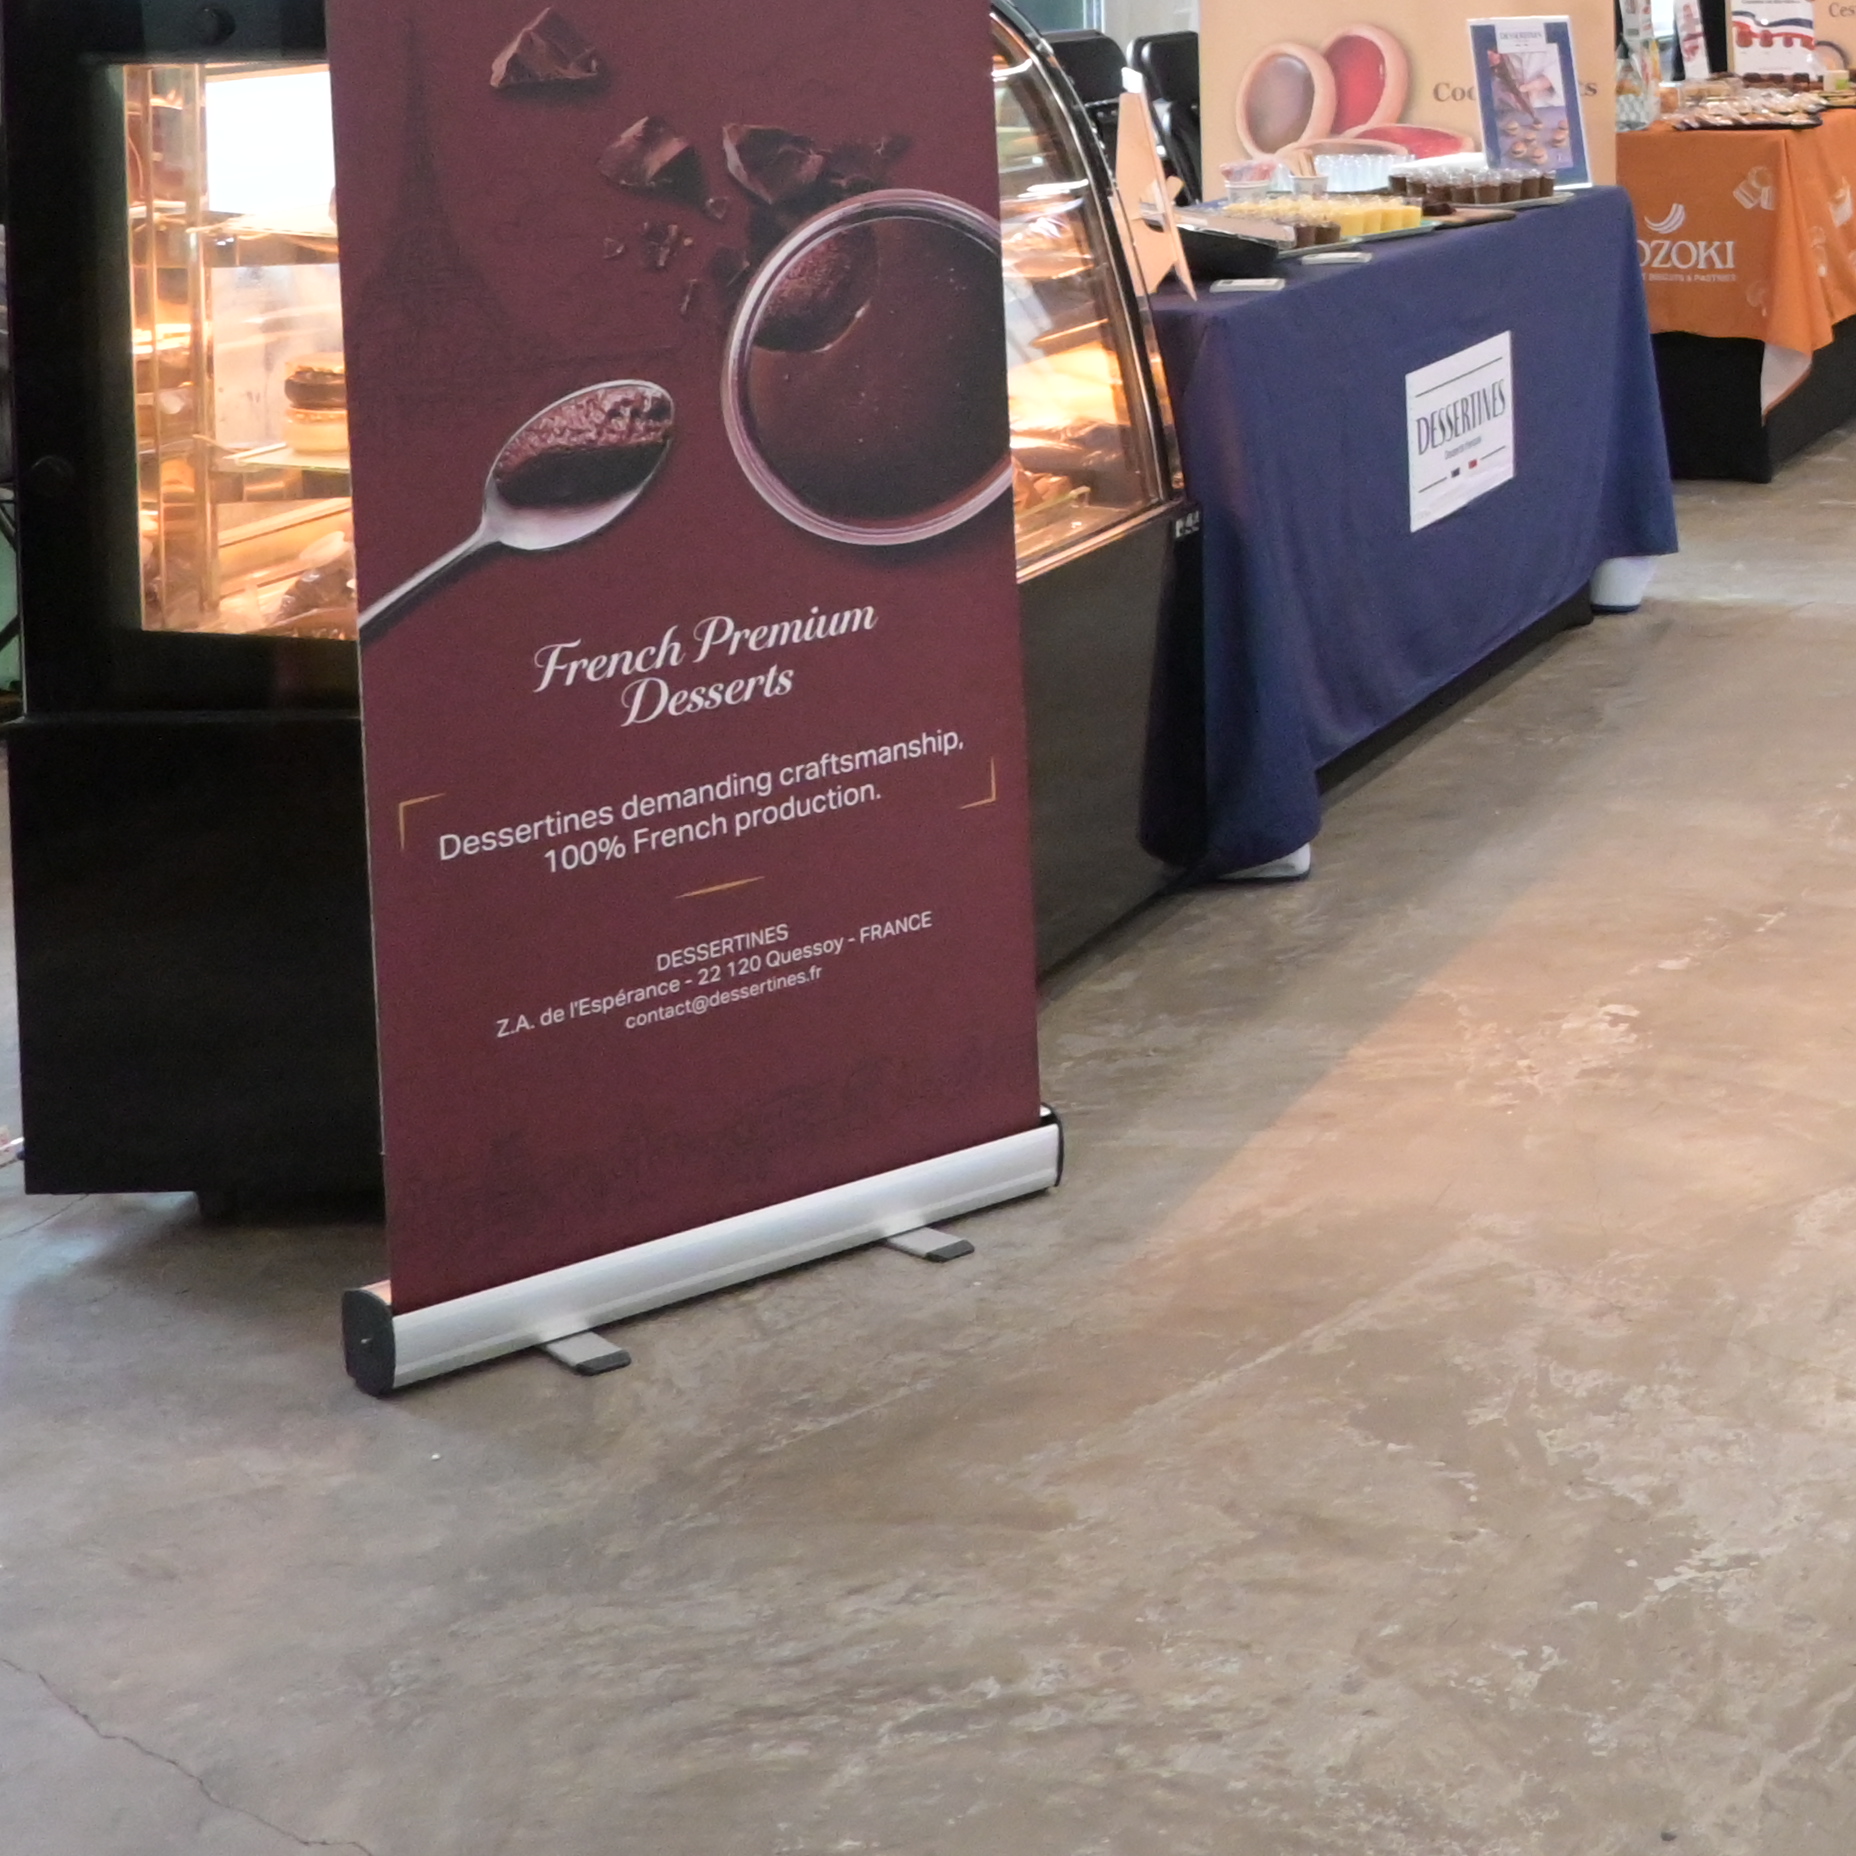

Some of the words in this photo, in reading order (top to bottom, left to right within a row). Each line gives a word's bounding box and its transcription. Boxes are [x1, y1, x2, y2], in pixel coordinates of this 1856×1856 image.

[1636, 240, 1735, 269] OZOKI
[1416, 379, 1505, 455] DESSERTINES
[533, 625, 685, 693] French
[693, 605, 878, 661] Premium
[620, 663, 795, 727] Desserts
[439, 803, 614, 860] Dessertines
[621, 771, 772, 820] demanding
[779, 729, 964, 787] craftsmanship,
[545, 840, 627, 873] 100%
[633, 816, 728, 854] French
[734, 781, 882, 836] production.
[496, 1016, 534, 1038] Z.A.
[540, 1005, 565, 1026] de
[570, 975, 681, 1021] l'Espérance
[698, 967, 722, 986] 22
[727, 957, 761, 980] 120
[766, 937, 844, 972] Quessoy
[860, 911, 932, 944] FRANCE
[655, 923, 789, 971] DESSERTINES
[625, 964, 823, 1030] contact@dessertines.fr
